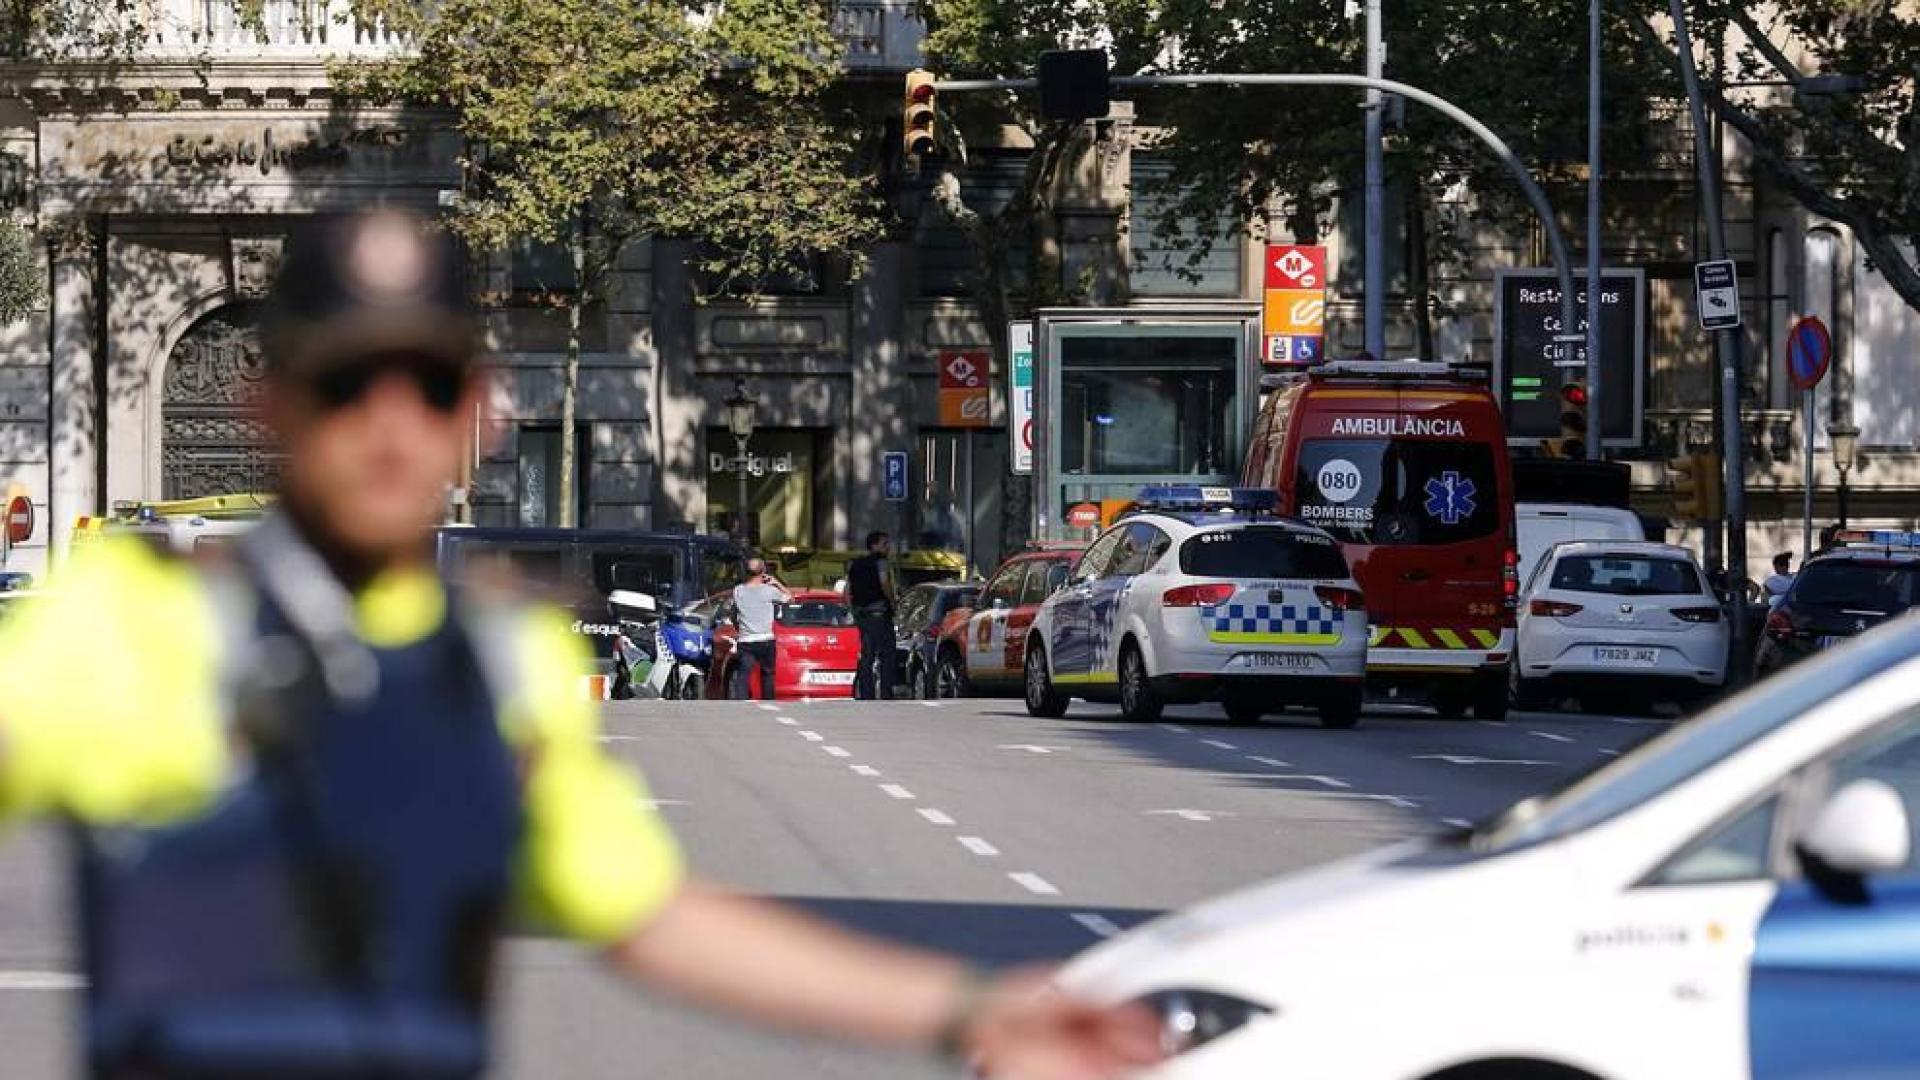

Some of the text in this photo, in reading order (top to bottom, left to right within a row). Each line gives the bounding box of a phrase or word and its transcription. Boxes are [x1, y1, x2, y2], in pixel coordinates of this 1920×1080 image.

[1520, 289, 1619, 303] Restrcns
[1331, 415, 1465, 436] AMBULÀNCIA
[710, 452, 792, 476] Deigual
[1321, 472, 1359, 490] 080
[1302, 505, 1374, 520] BOMBERS
